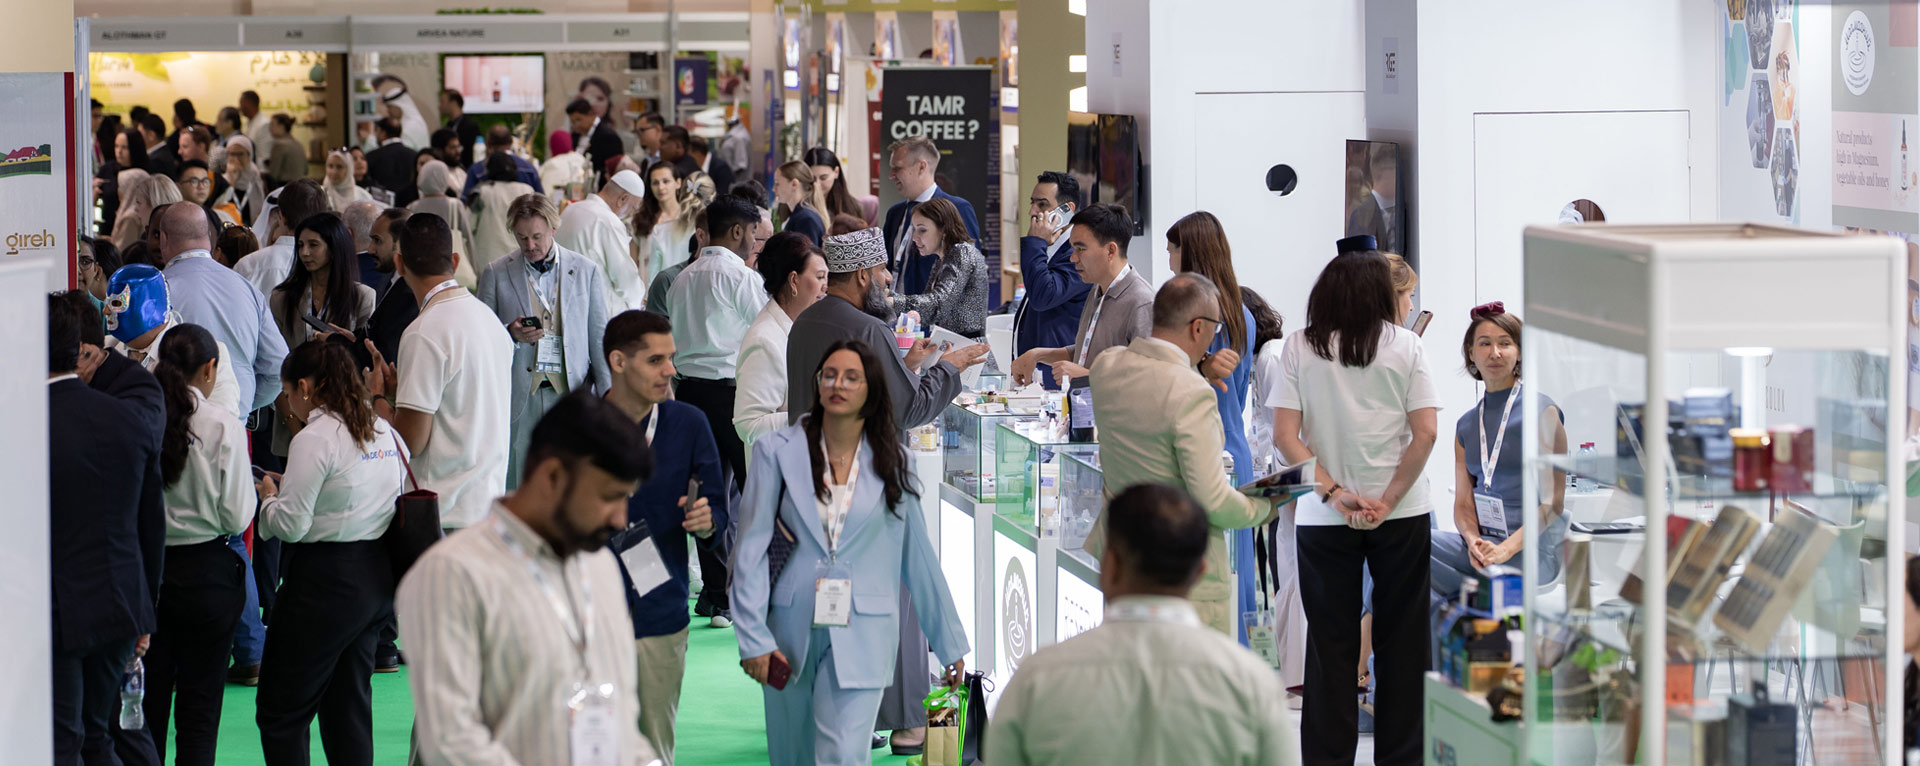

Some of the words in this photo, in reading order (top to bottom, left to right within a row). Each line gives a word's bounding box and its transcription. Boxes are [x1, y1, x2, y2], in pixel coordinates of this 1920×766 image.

[417, 29, 447, 38] ARVEA
[449, 28, 485, 38] NATURE
[906, 95, 966, 116] TAMR
[1836, 129, 1853, 144] Natural
[1853, 130, 1873, 148] products
[1836, 171, 1857, 187] vegetable
[6, 229, 55, 255] gireh
